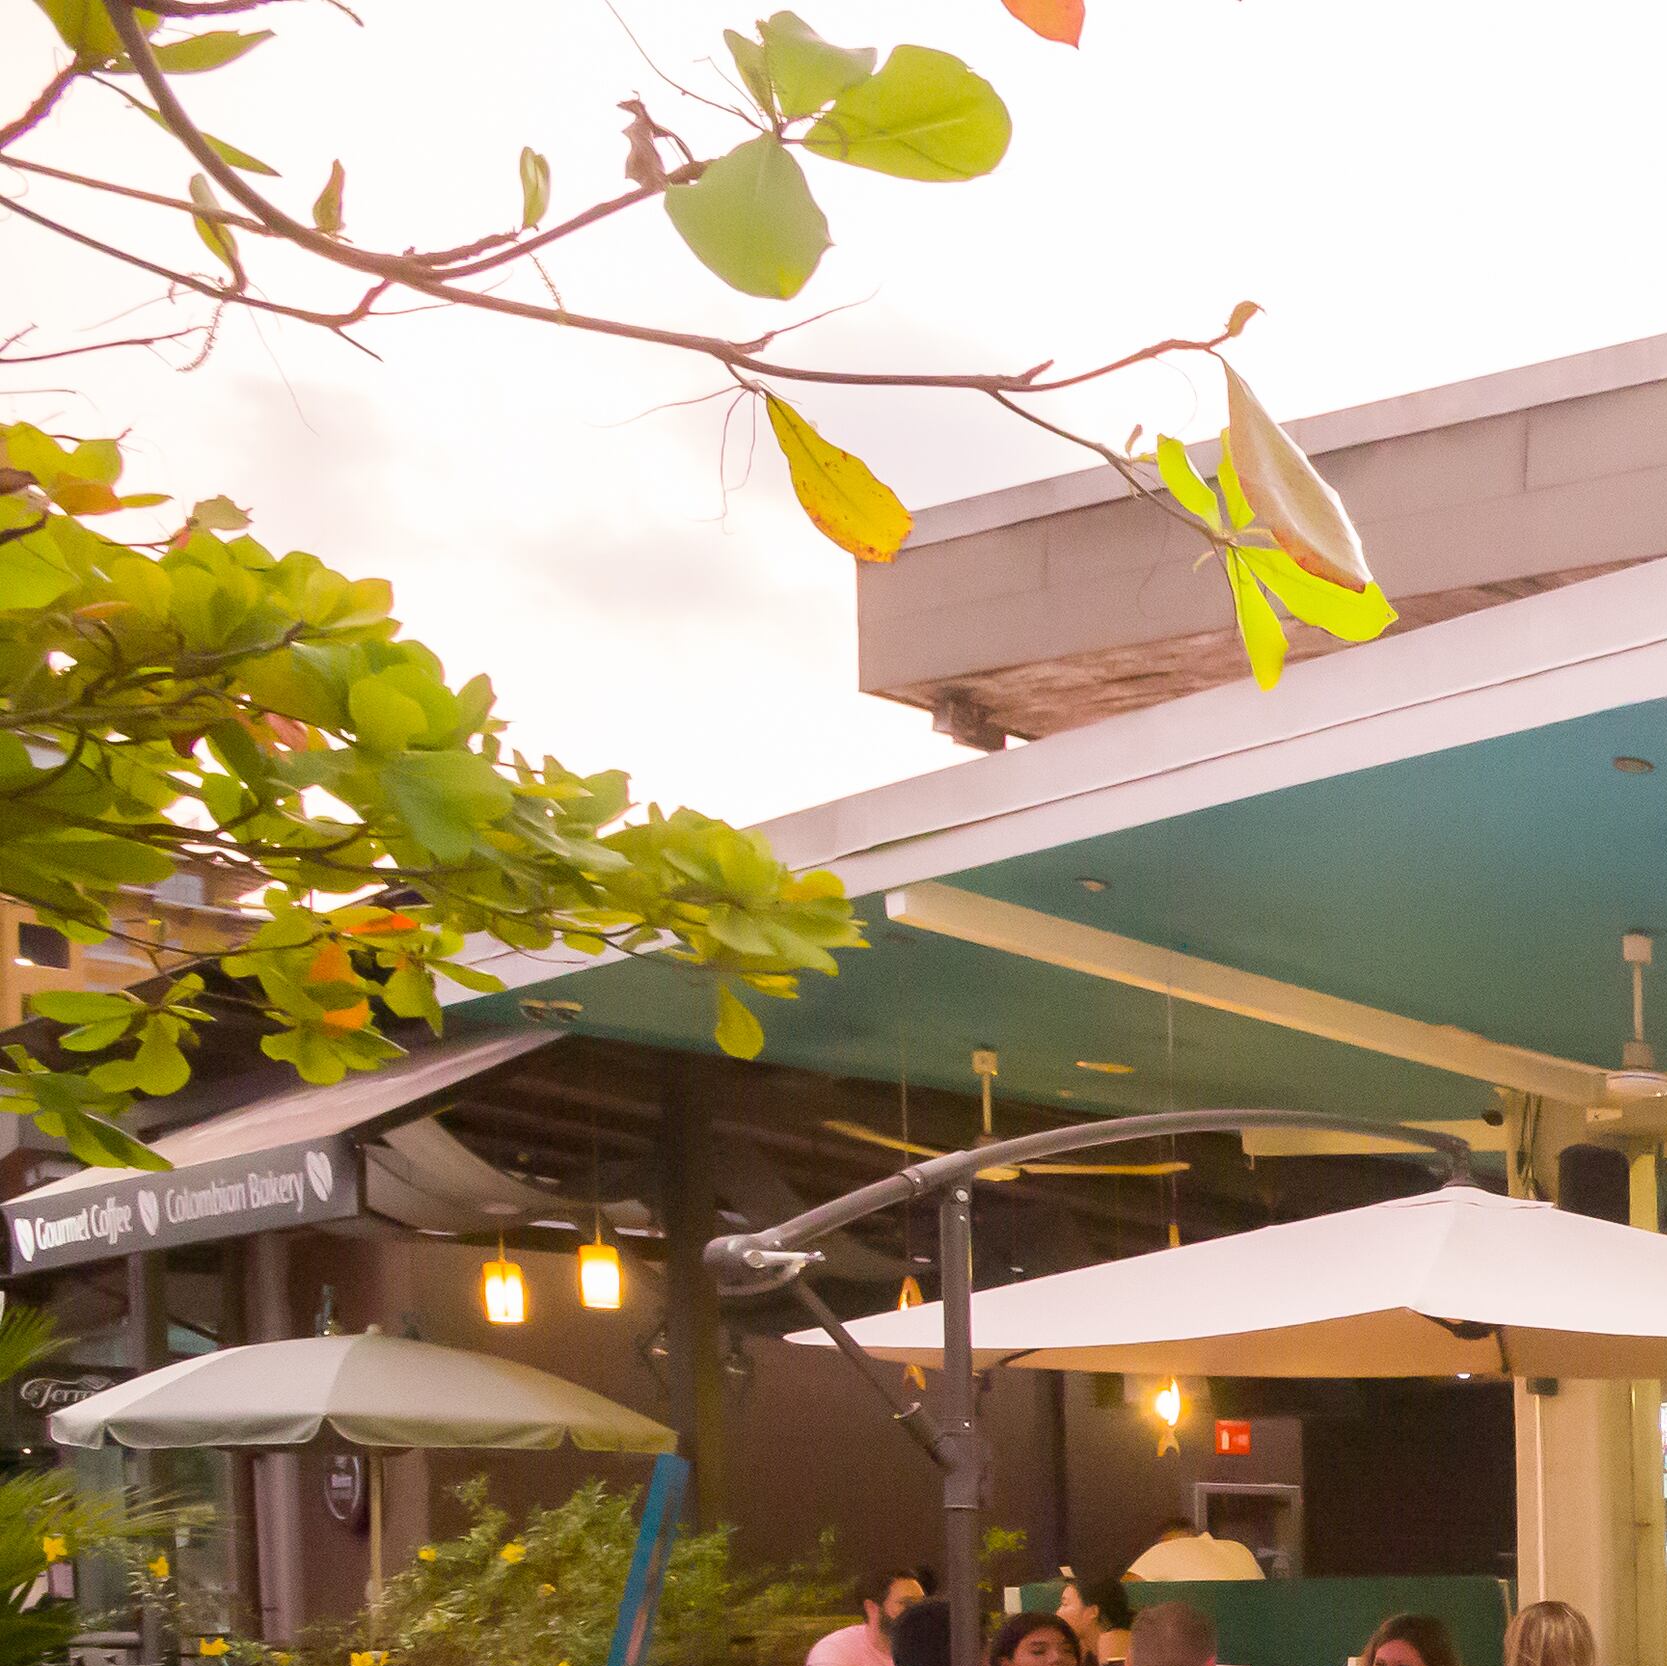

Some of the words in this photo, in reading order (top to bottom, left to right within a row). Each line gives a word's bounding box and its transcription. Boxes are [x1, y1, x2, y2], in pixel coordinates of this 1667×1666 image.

[35, 1208, 90, 1250] Gourmet
[91, 1196, 133, 1245] Coffee
[165, 1179, 248, 1225] Colombian
[249, 1171, 304, 1213] Bakery
